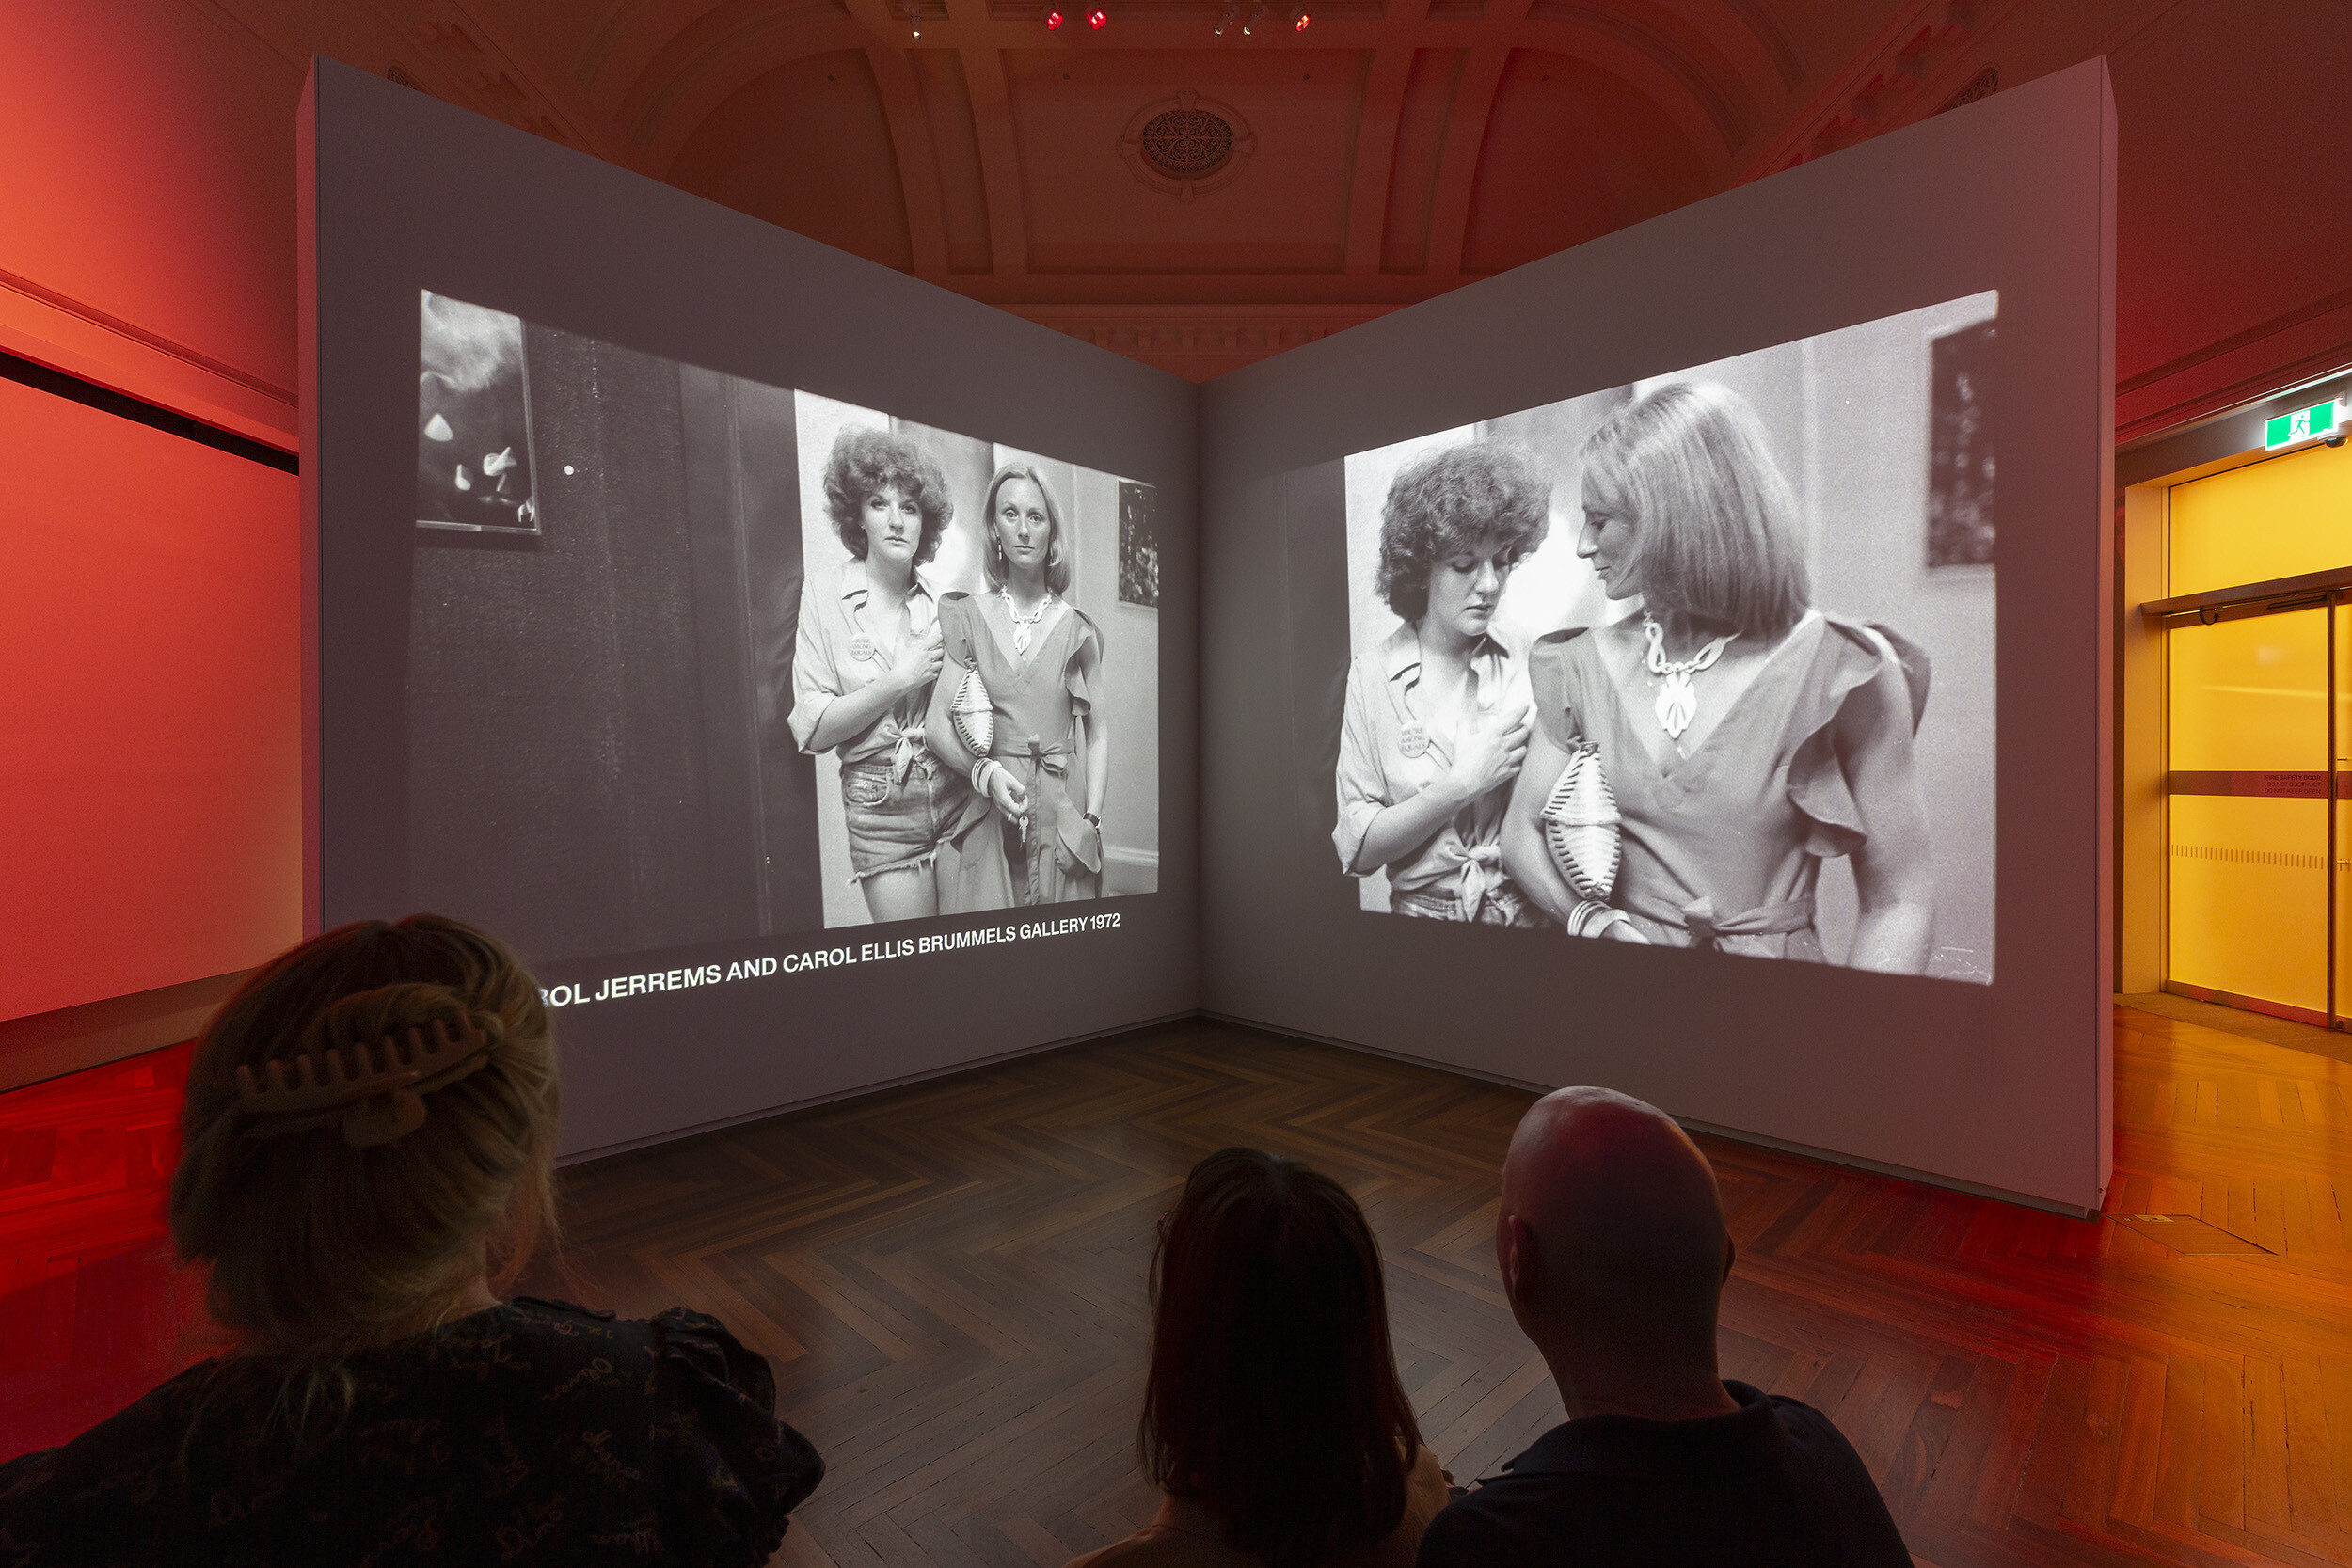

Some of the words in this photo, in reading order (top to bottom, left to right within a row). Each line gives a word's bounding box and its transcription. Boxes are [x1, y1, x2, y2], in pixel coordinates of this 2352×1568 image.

[594, 964, 722, 1001] JERREMS
[726, 957, 778, 982] AND
[782, 946, 858, 974] CAROL
[862, 938, 914, 962] ELLIS
[918, 925, 1016, 954] BRUMMELS
[1019, 916, 1089, 940] GALLERY
[1089, 912, 1121, 930] 1972
